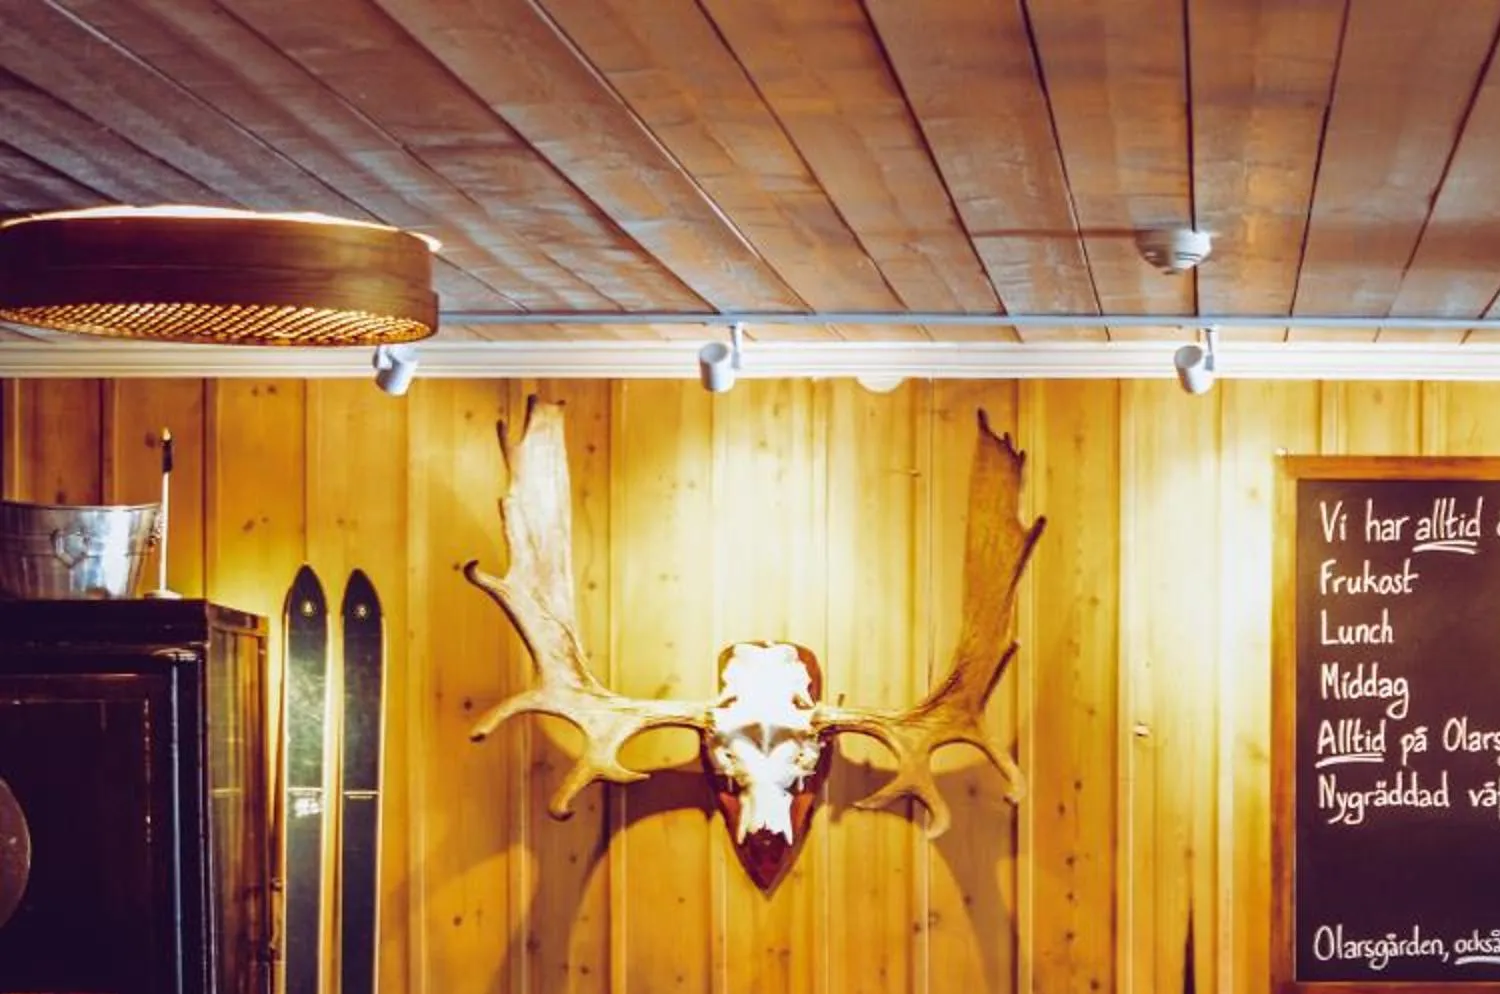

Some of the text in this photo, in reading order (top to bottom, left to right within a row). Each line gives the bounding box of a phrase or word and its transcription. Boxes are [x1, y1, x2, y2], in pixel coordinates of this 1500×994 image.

[1319, 500, 1348, 544] Vi
[1364, 497, 1410, 543] har
[1413, 495, 1484, 540] alltid
[1319, 557, 1419, 596] Frukost
[1320, 607, 1395, 646] Lunch
[1320, 661, 1410, 720] Middag
[1317, 718, 1387, 756] Alltid
[1400, 725, 1429, 767] på
[1317, 770, 1451, 826] Nygräddad
[1312, 923, 1450, 971] Olarsgården,
